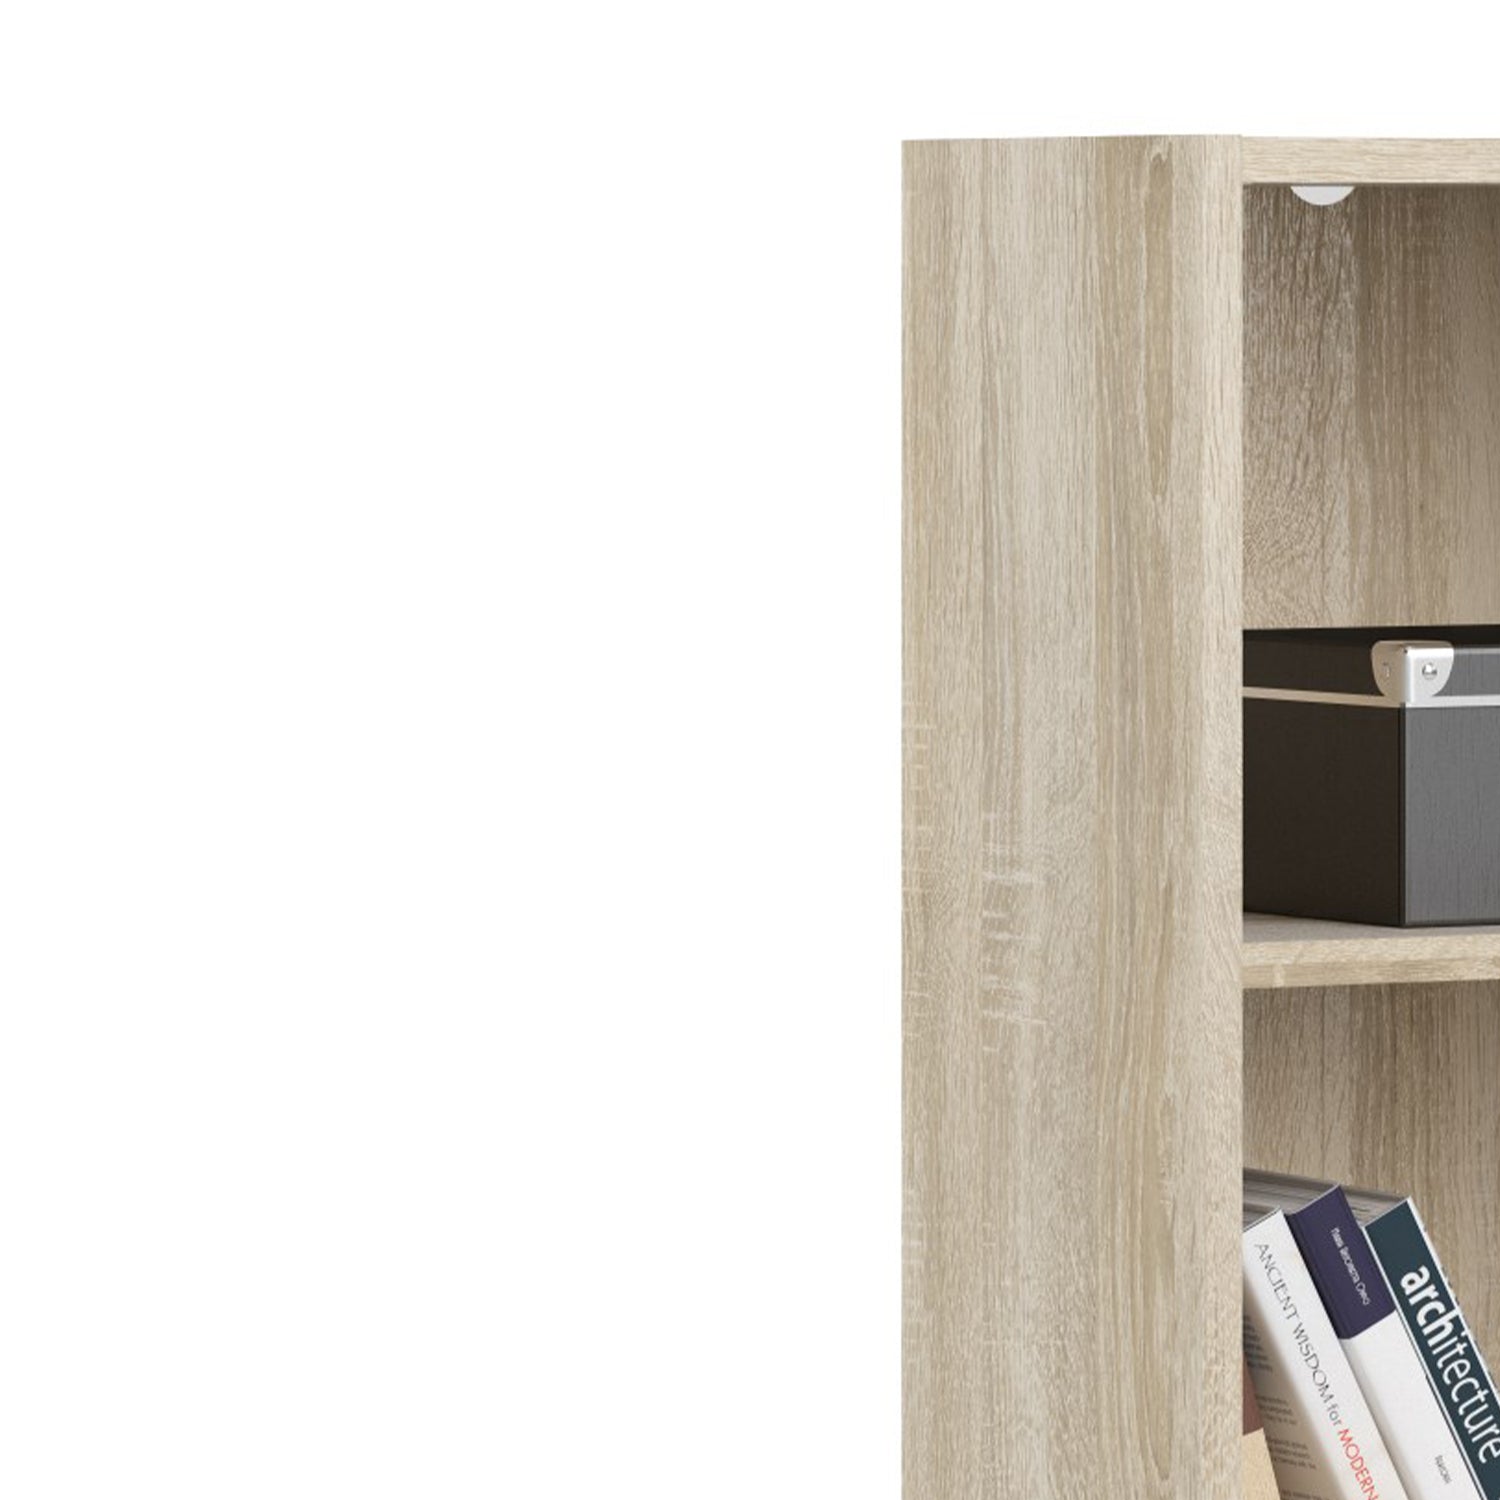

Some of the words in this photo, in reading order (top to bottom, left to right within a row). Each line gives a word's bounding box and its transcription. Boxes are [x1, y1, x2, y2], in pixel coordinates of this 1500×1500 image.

[1254, 1243, 1299, 1320] ANCIENT
[1293, 1323, 1335, 1405] WISDOM
[1327, 1400, 1343, 1426] for
